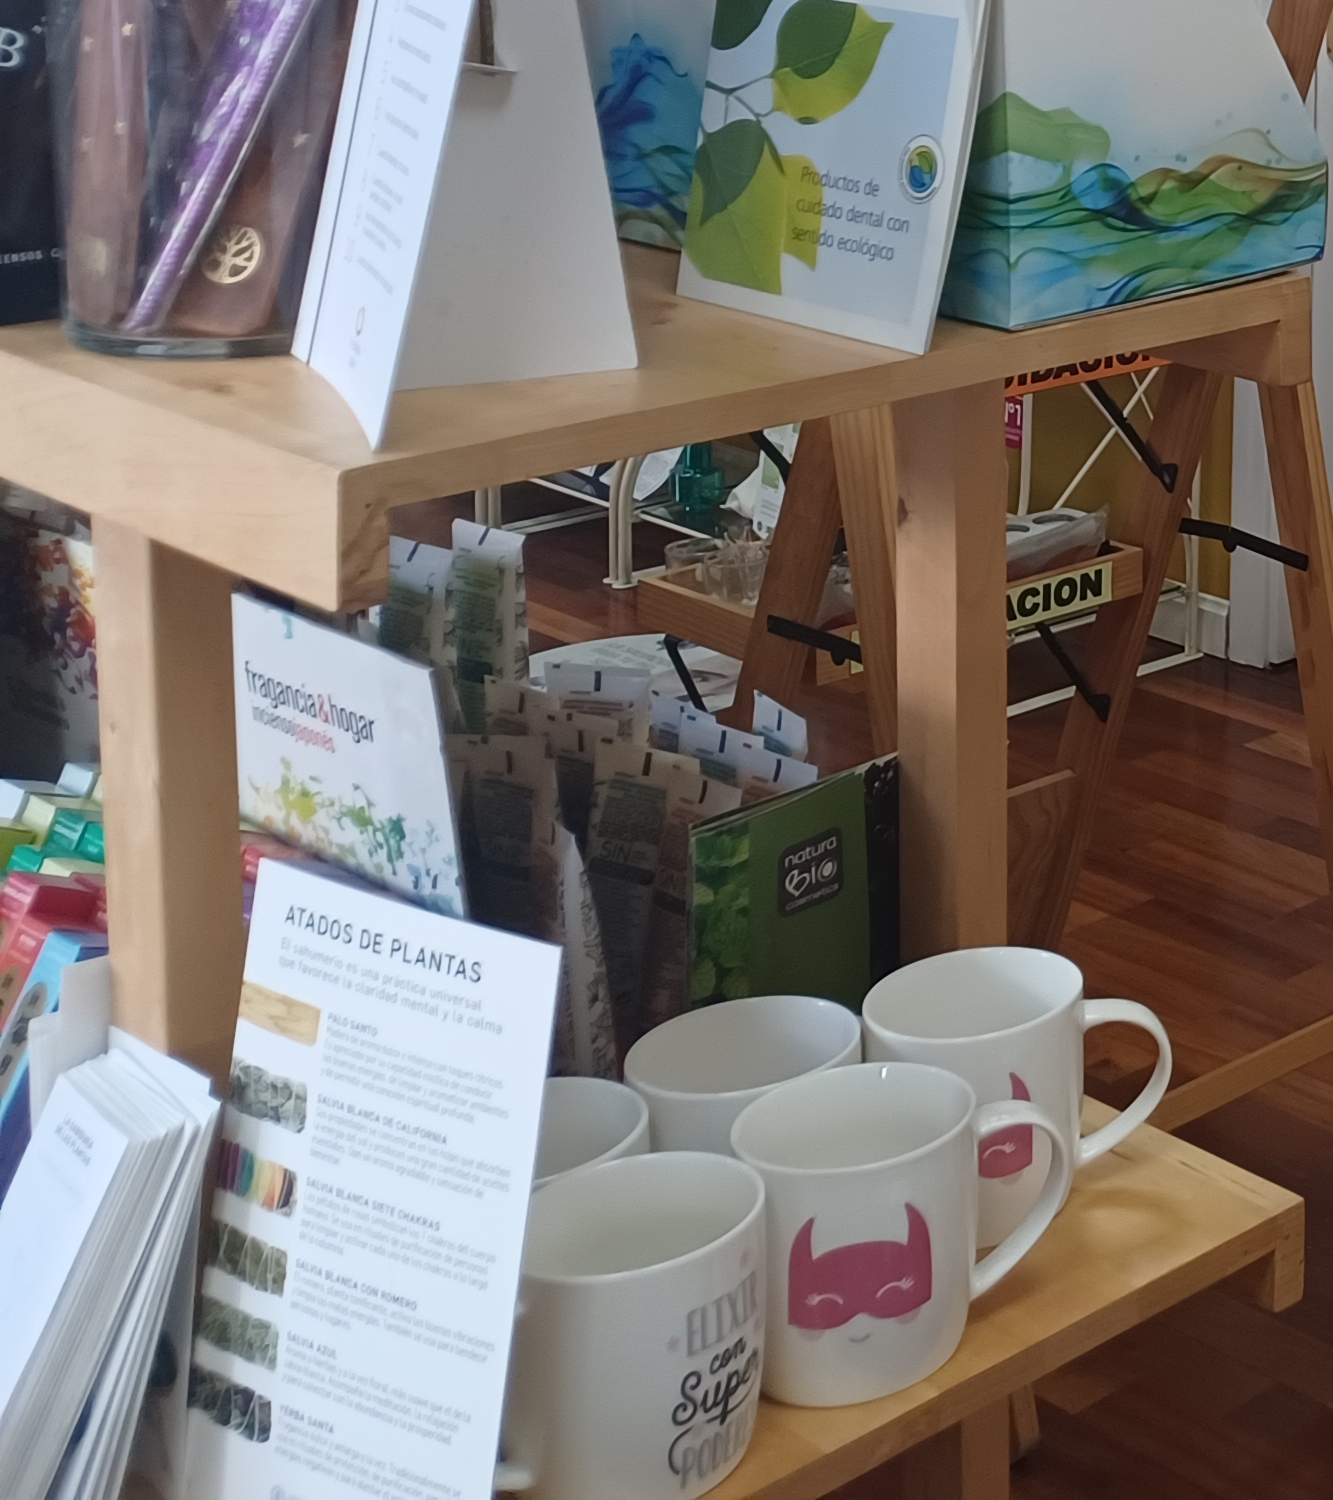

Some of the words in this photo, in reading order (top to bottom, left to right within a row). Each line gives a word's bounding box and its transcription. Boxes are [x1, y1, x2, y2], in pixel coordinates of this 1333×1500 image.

[801, 165, 861, 194] Productos
[864, 178, 880, 198] de
[796, 198, 843, 220] cuidado
[846, 205, 884, 228] dental
[887, 217, 910, 234] con
[792, 226, 835, 248] sentido
[837, 236, 895, 262] ecológico
[784, 835, 837, 868] natura
[785, 882, 840, 912] cosmetics
[285, 904, 354, 945] ATADOS
[359, 928, 384, 955] DE
[389, 937, 483, 984] PLANTAS
[280, 937, 291, 951] El
[293, 942, 344, 970] sahumerio
[346, 961, 358, 974] es
[360, 965, 380, 980] una
[382, 974, 427, 998] práctica
[429, 985, 482, 1013] universal
[278, 955, 295, 972] que
[297, 960, 342, 986] favorece
[343, 976, 352, 990] la
[354, 979, 399, 1005] claridad
[400, 994, 439, 1018] mental
[441, 1009, 450, 1022] y
[452, 1010, 464, 1024] la
[466, 1013, 503, 1036] calma
[327, 1011, 349, 1029] PALO
[350, 1019, 379, 1038] SANTO
[317, 1092, 346, 1112] SALVIA
[347, 1103, 381, 1124] BLANCA
[395, 1119, 448, 1146] CALIFORNIA
[306, 1175, 334, 1196] SALVIA
[335, 1186, 370, 1208] BLANCA
[371, 1199, 396, 1219] SIETE
[397, 1208, 441, 1233] CHAKRAS
[295, 1257, 323, 1279] SALVIA
[324, 1268, 359, 1292] BLANCA
[380, 1290, 418, 1312] ROMERO
[709, 1336, 748, 1375] con
